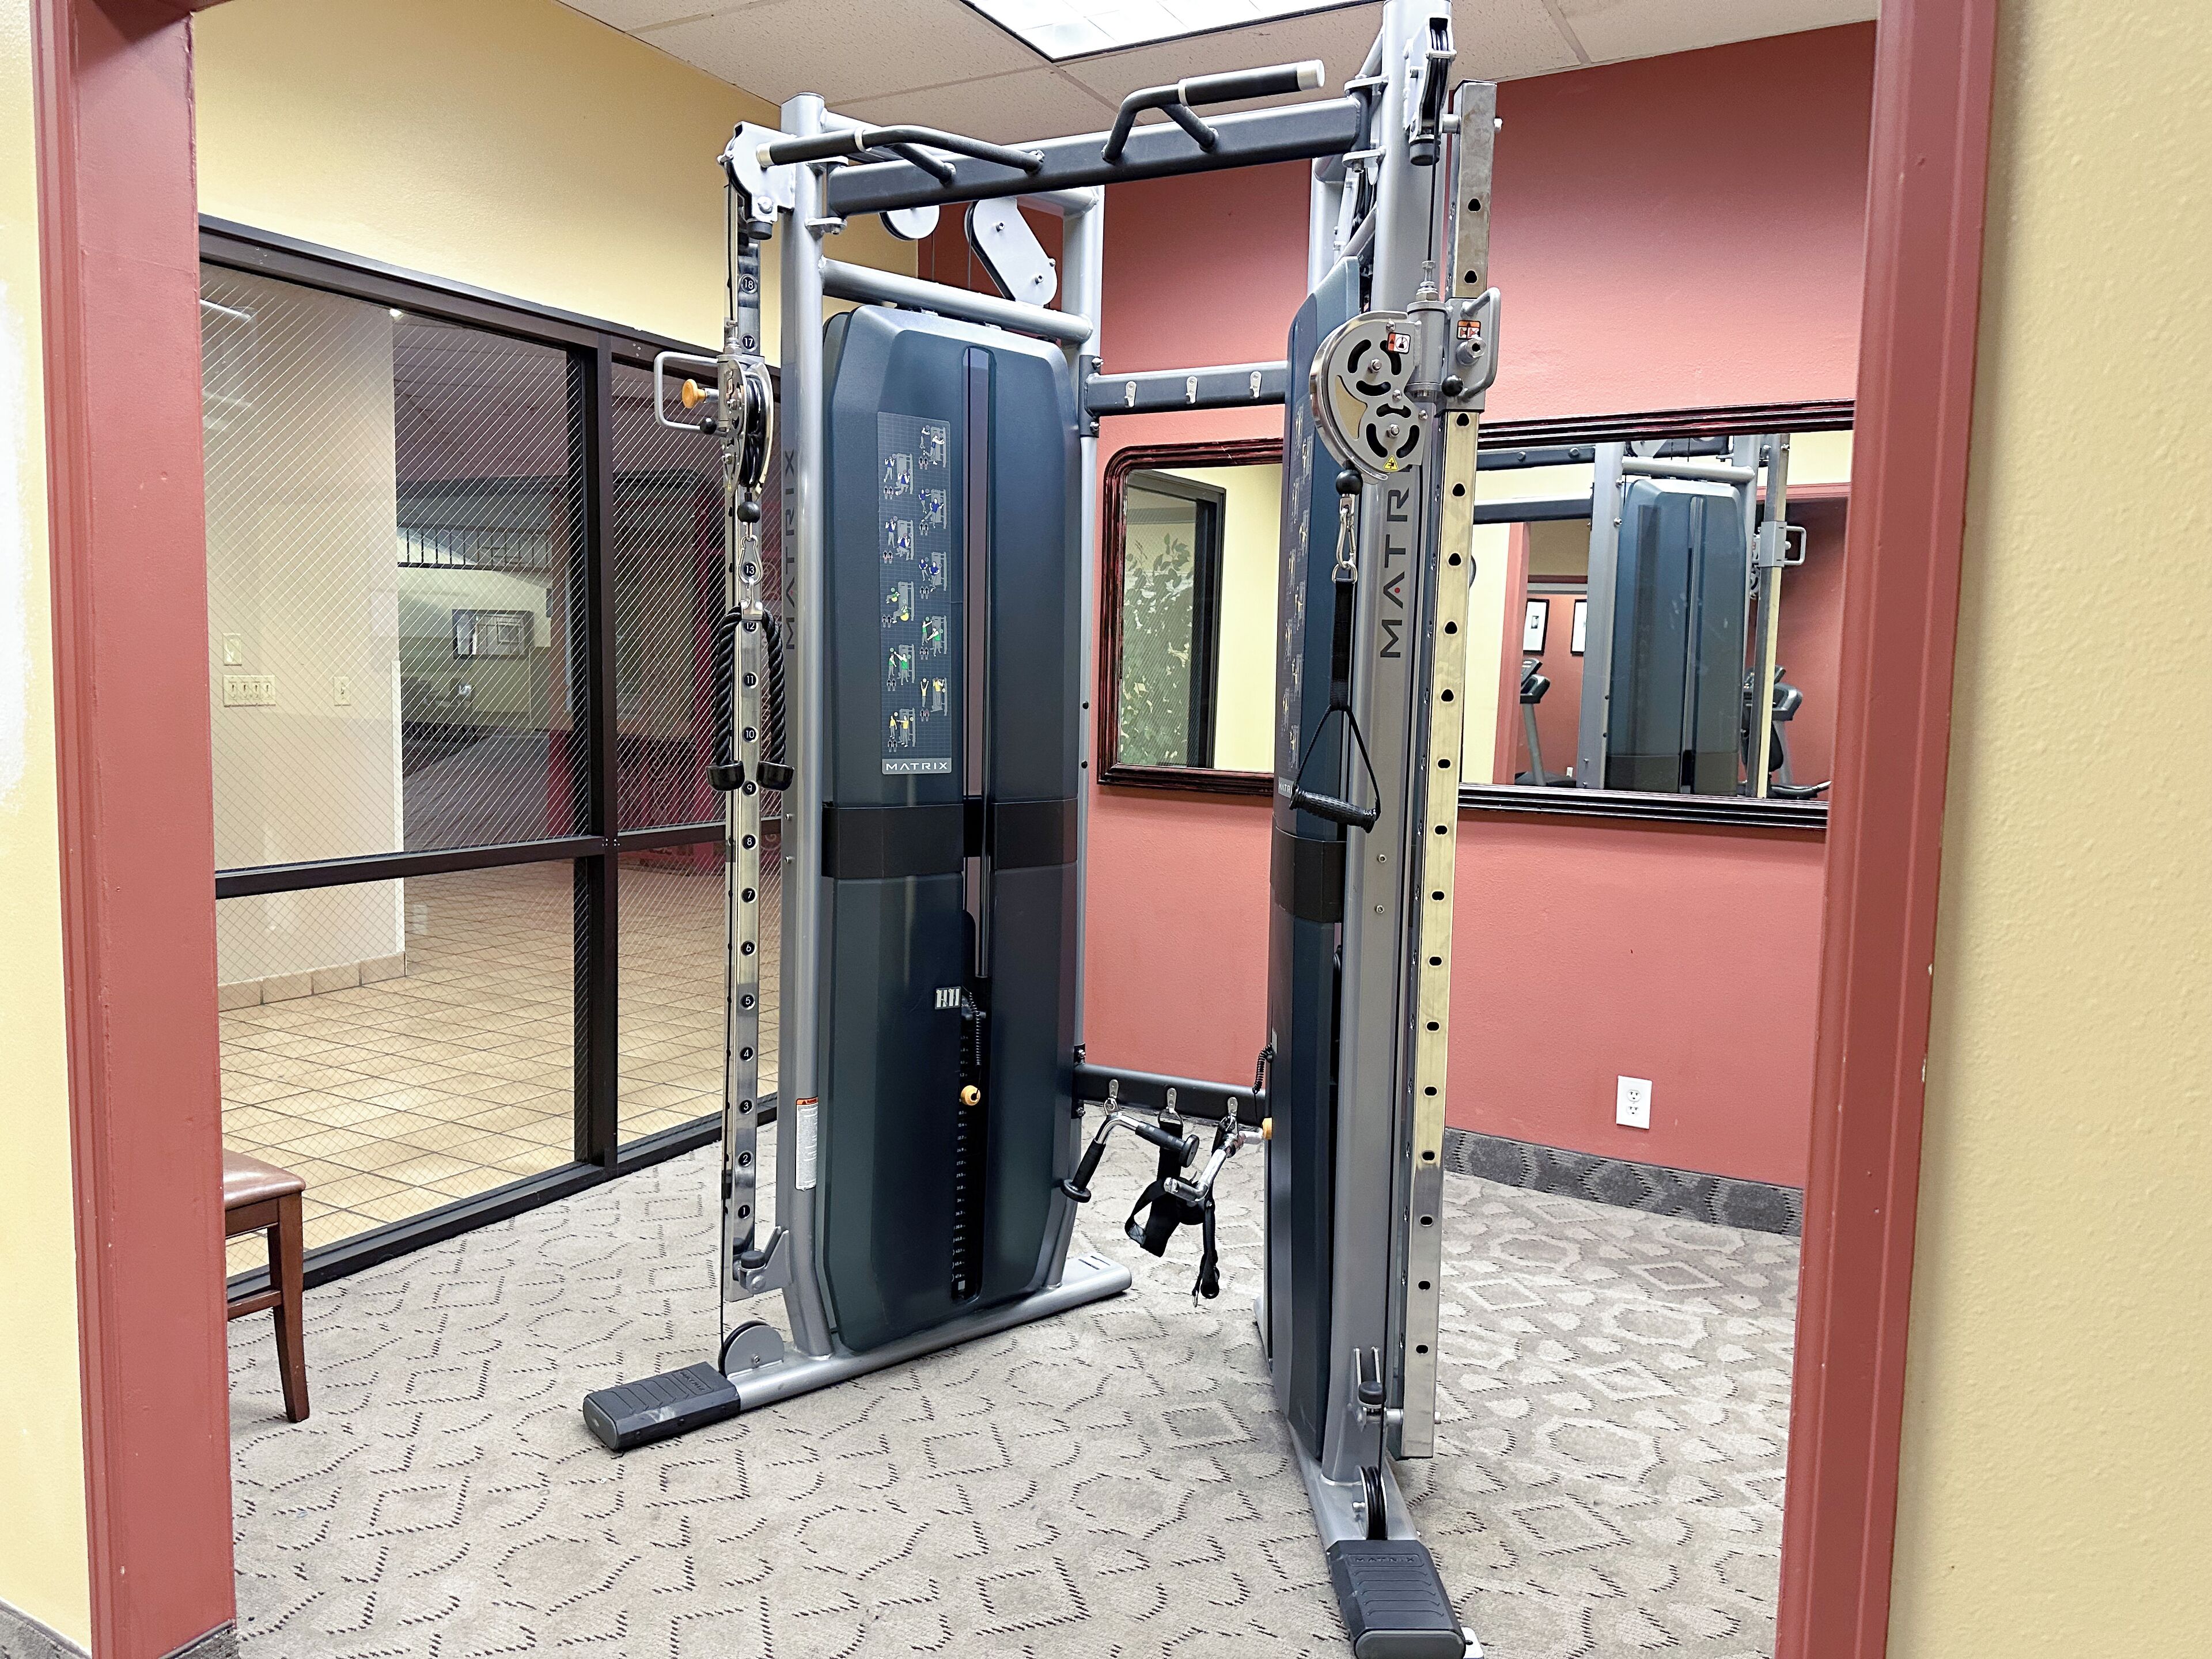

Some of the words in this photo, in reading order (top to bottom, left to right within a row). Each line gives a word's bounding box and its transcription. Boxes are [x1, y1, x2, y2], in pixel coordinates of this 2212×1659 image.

[744, 279, 753, 289] 18
[744, 338, 753, 347] 17
[785, 449, 795, 650] MATRIX
[1380, 464, 1410, 658] MATR
[746, 566, 754, 574] 13
[747, 676, 753, 684] 11
[746, 730, 754, 738] 10
[886, 762, 948, 771] MATRIX
[747, 838, 752, 846] 8
[680, 1372, 705, 1391] MATRIX
